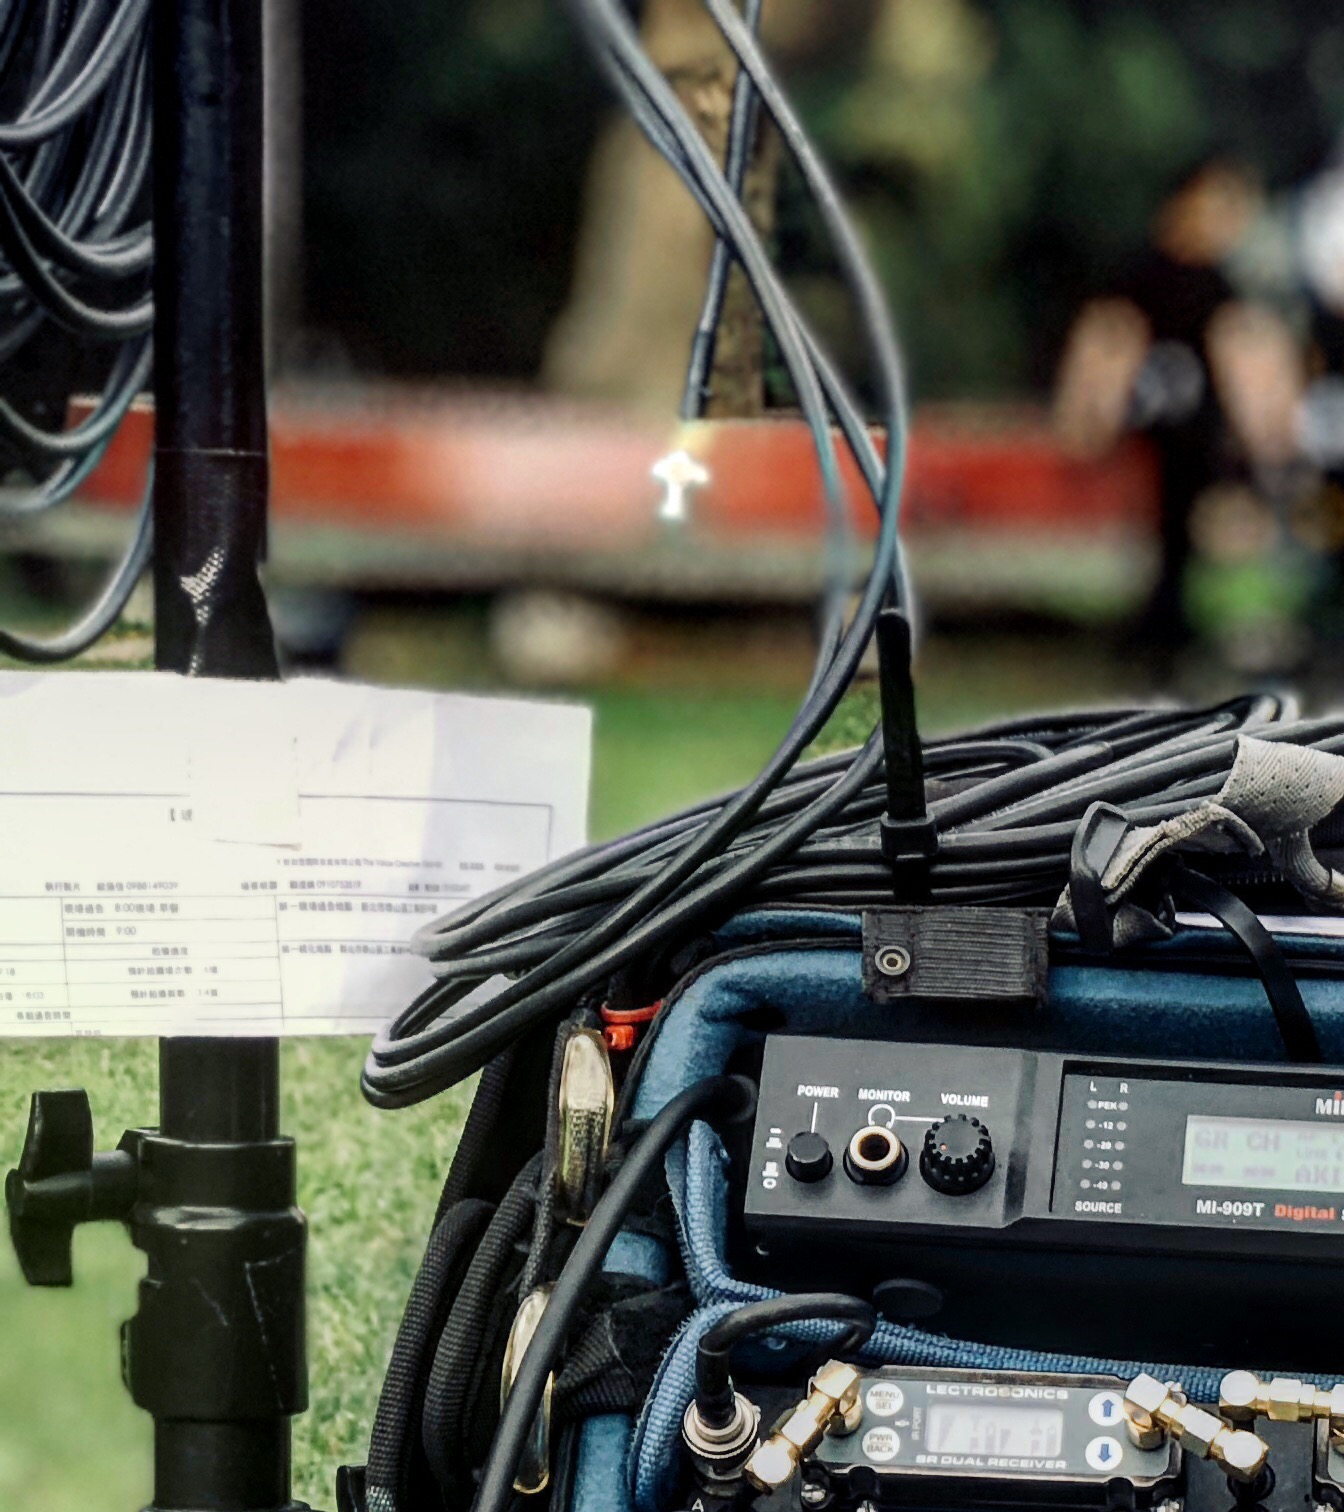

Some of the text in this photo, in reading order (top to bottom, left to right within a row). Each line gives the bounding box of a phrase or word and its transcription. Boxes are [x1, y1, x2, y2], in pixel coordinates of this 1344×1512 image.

[797, 1085, 840, 1100] POWER
[858, 1088, 911, 1103] MONITOR
[940, 1093, 989, 1109] VOLUME
[1074, 1201, 1123, 1215] SOURCE
[1196, 1200, 1265, 1218] MI-909T
[1274, 1203, 1335, 1223] Digital
[925, 1384, 1069, 1401] LECTROSONICS
[941, 1456, 1066, 1470] DUAL RECEIVER
